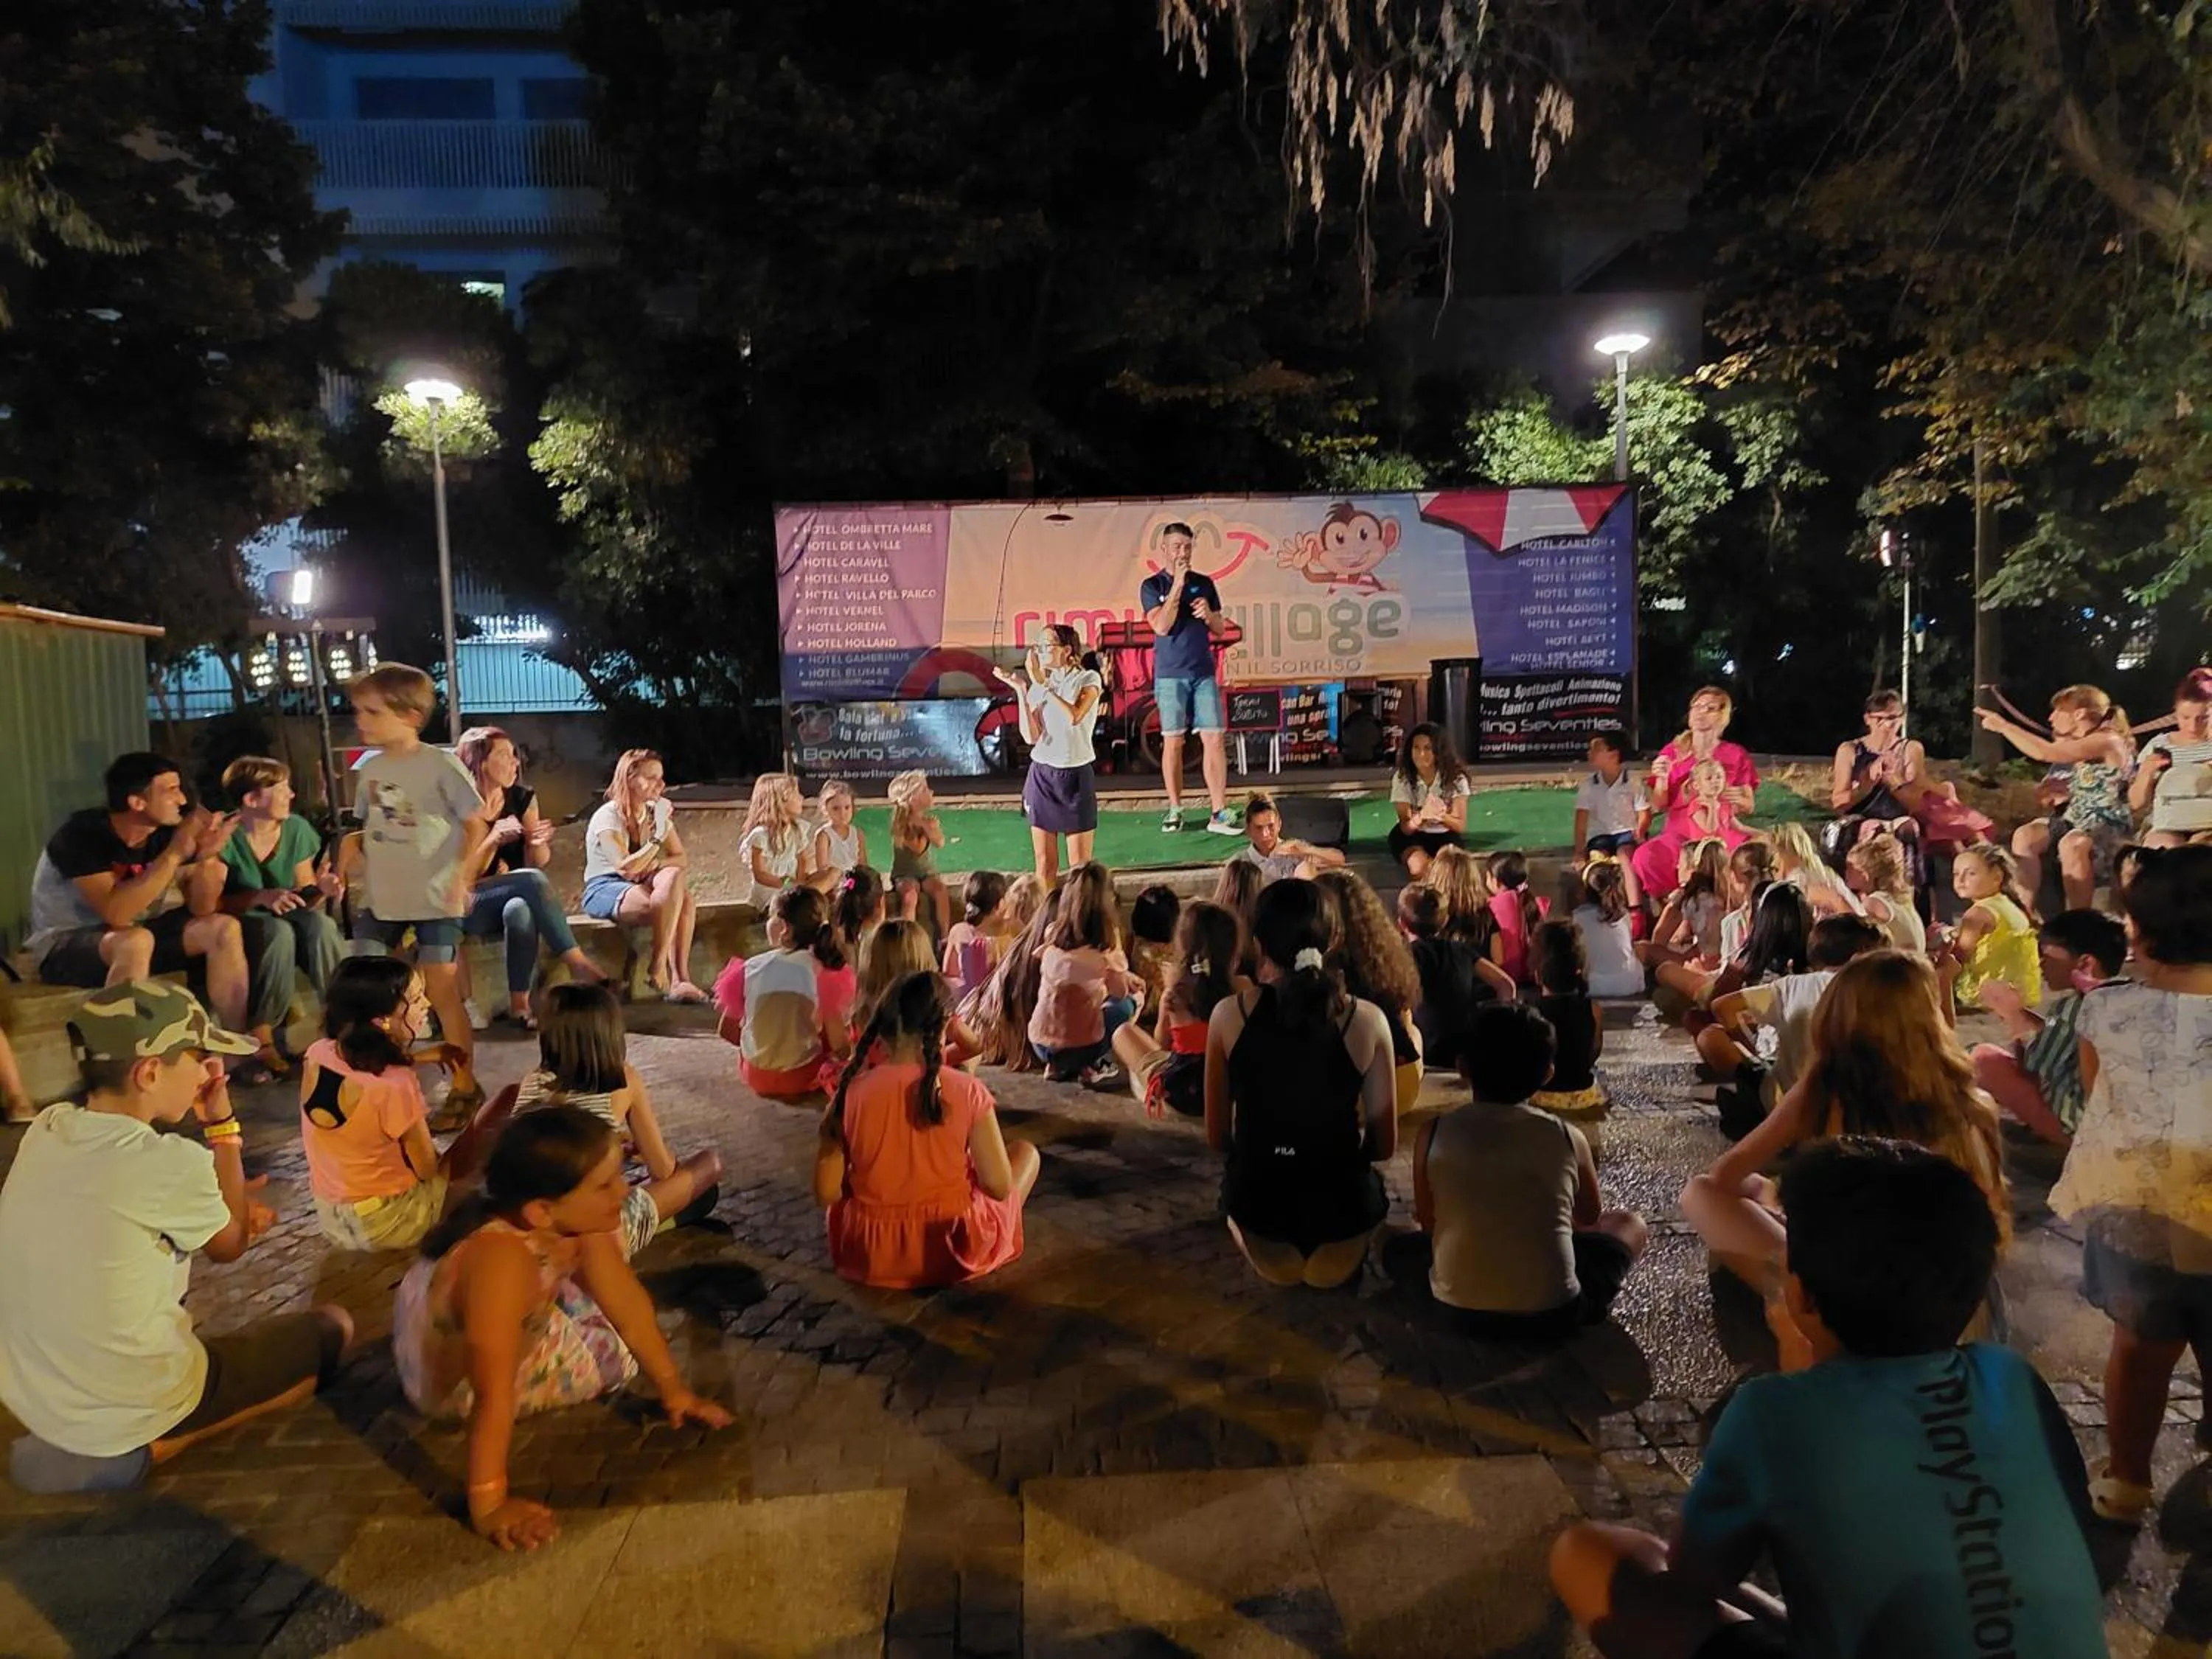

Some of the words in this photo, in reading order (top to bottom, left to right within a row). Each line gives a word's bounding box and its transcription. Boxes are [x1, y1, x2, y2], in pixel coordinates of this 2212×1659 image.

[902, 523, 933, 535] MARE
[841, 540, 854, 551] DE
[857, 540, 871, 551] LA
[872, 540, 901, 551] VILLE
[1521, 539, 1554, 550] HOTEL
[804, 557, 838, 568] HOTEL
[1518, 557, 1549, 567] HOTEL
[804, 574, 839, 583] HOTEL
[841, 573, 890, 583] RAVELLO
[1533, 572, 1566, 583] HOTEL
[805, 590, 840, 600] HOTEL
[847, 590, 876, 600] VILLA
[879, 590, 900, 600] DEL
[1535, 589, 1568, 599] HOTEL
[806, 605, 840, 616] HOTEL
[1520, 605, 1554, 616] HOTEL
[807, 622, 842, 633] HOTEL
[1225, 598, 1402, 658] illage
[807, 639, 843, 649] HOTEL
[845, 638, 897, 649] HOLLAND
[808, 654, 843, 664] HOTEL
[1270, 659, 1362, 674] SORRISO
[808, 668, 841, 678] HOTEL
[1520, 717, 1622, 733] Seventies
[804, 746, 883, 762] Bowling
[1274, 1146, 1295, 1156] FILA
